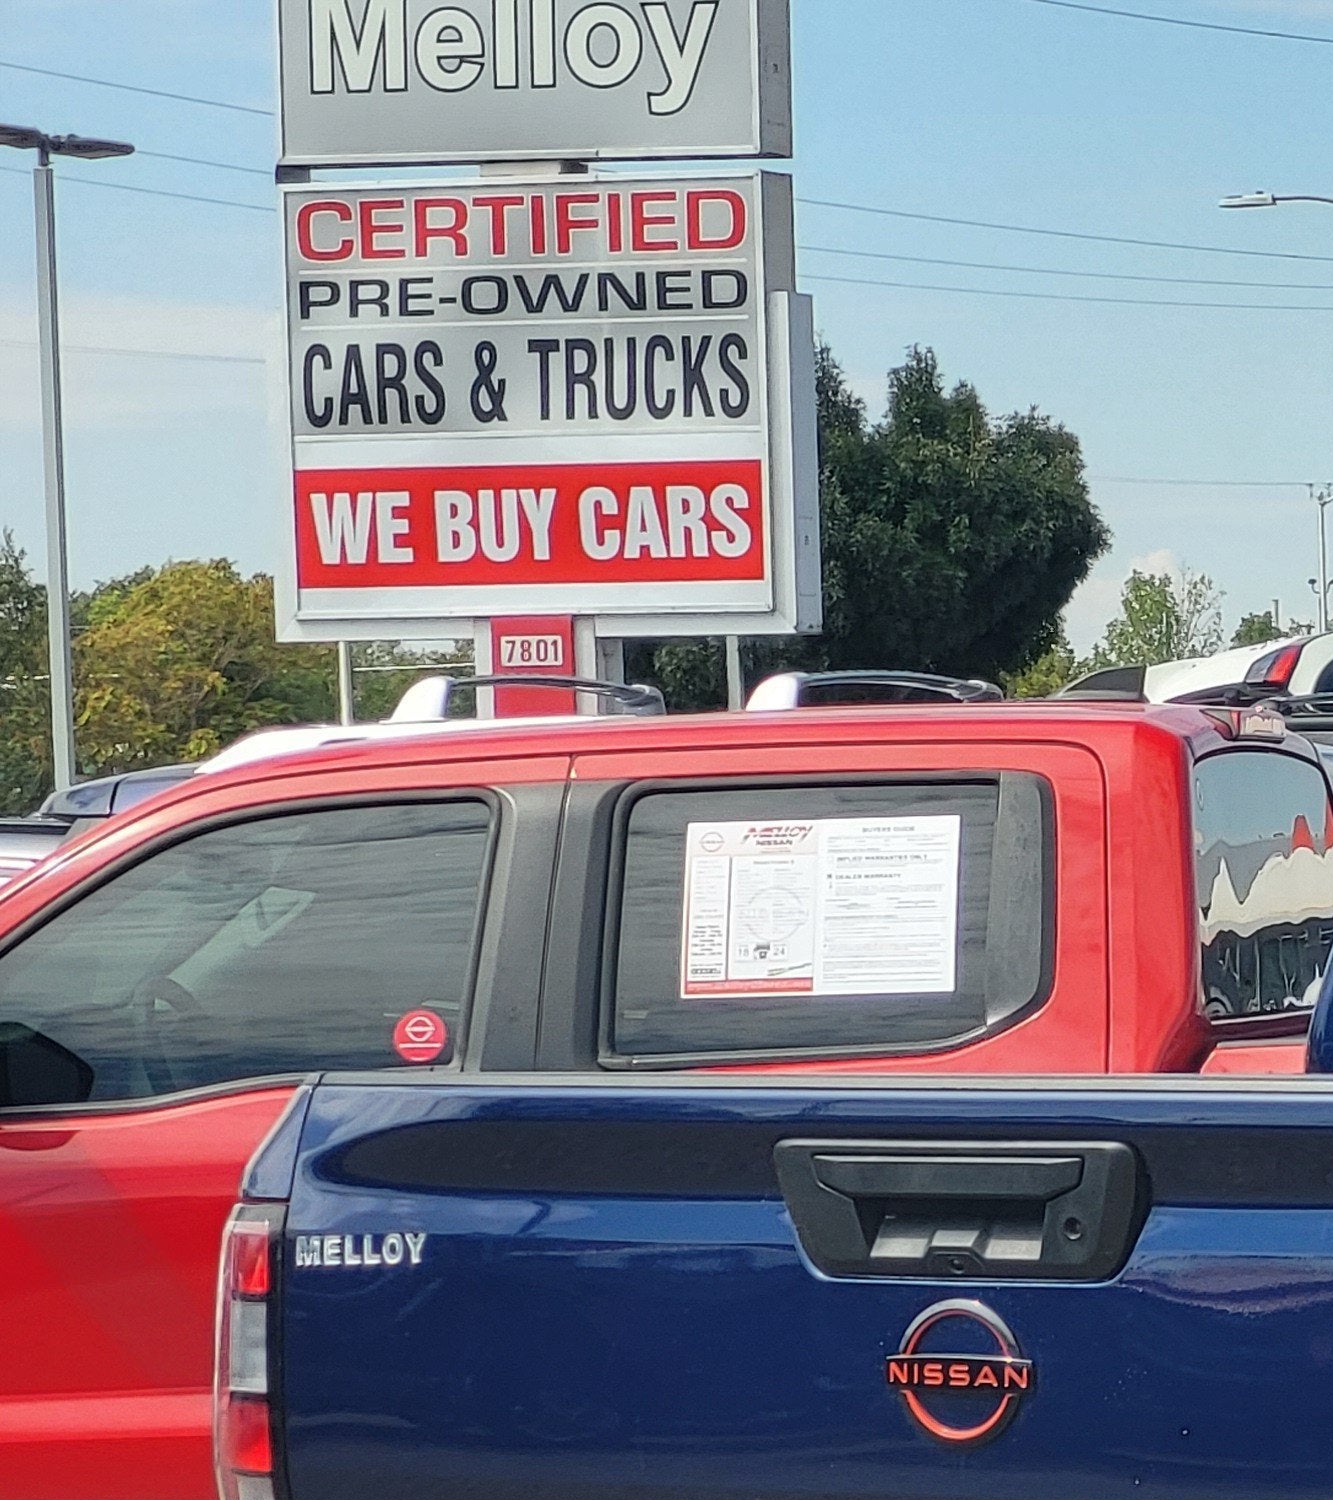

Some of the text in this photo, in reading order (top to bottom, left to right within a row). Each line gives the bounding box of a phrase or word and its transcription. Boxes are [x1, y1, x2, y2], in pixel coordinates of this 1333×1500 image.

[309, 0, 719, 116] Melloy
[296, 189, 748, 261] CERTIFIED
[299, 269, 748, 320] PRE-OWNED
[303, 333, 750, 427] CARS & TRUCKS
[310, 483, 752, 565] WE BUY CARS
[505, 639, 558, 663] 7801
[295, 1232, 427, 1267] MELLOY
[888, 1360, 1030, 1390] NISSAN
